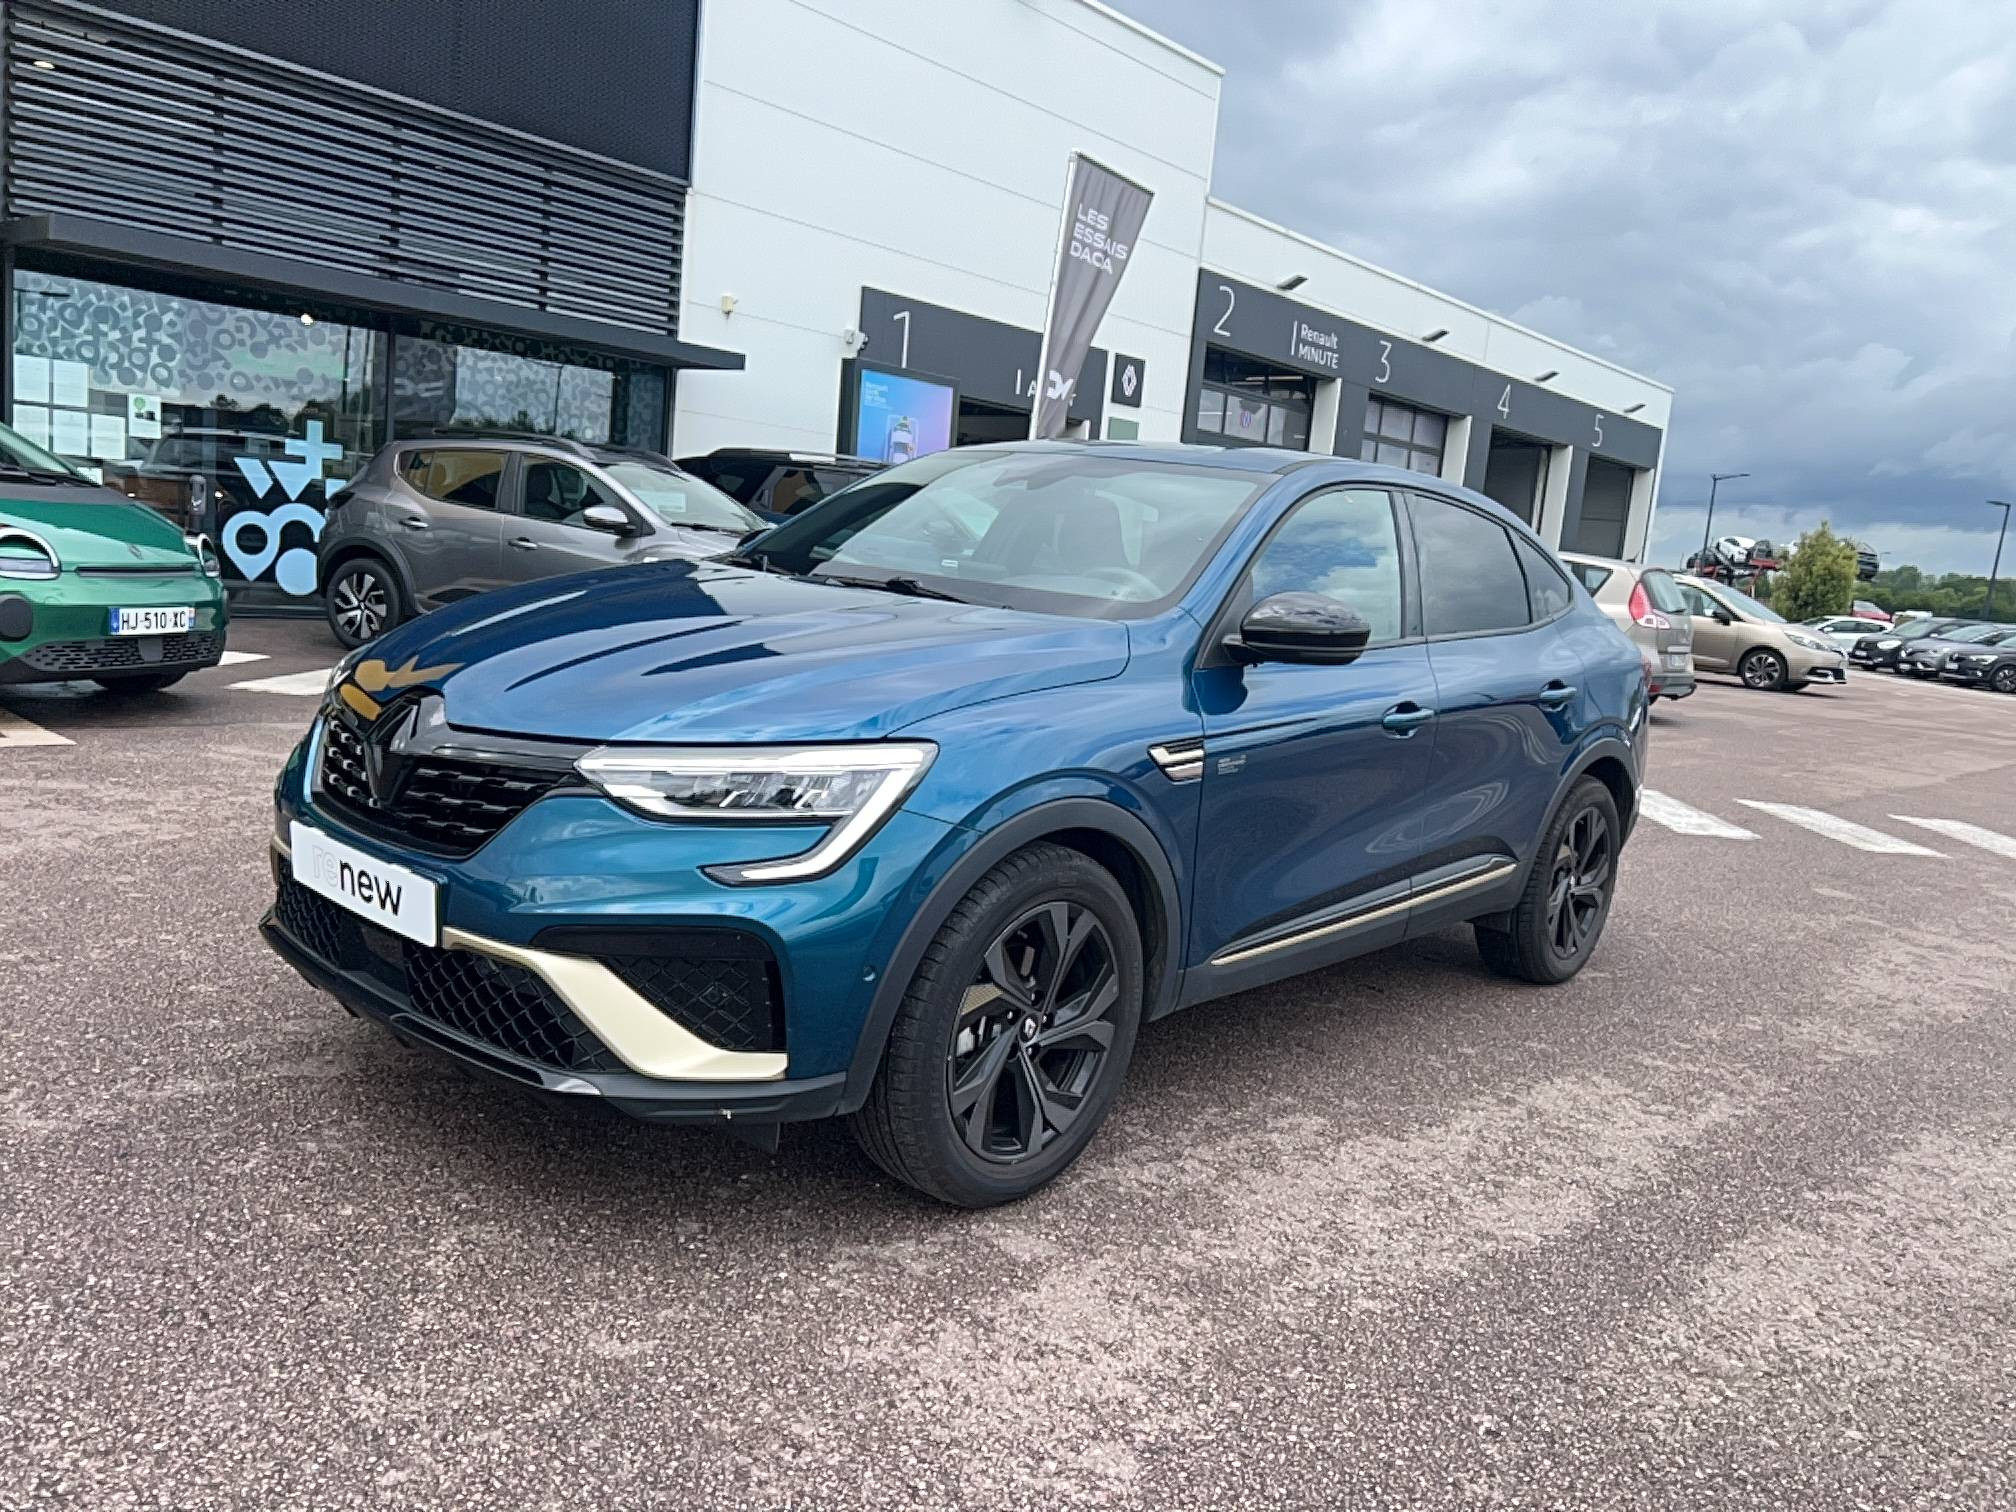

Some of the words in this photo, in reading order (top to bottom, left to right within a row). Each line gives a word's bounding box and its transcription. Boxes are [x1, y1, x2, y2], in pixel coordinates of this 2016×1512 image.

[1077, 203, 1109, 231] LES
[1073, 221, 1128, 259] ESSAIS
[1213, 285, 1236, 337] 2
[893, 310, 910, 369] 1
[1300, 323, 1338, 350] Renault
[1298, 342, 1339, 370] MINUTE
[1375, 340, 1392, 384] 3
[1497, 383, 1511, 420] 4
[1592, 413, 1605, 448] 5
